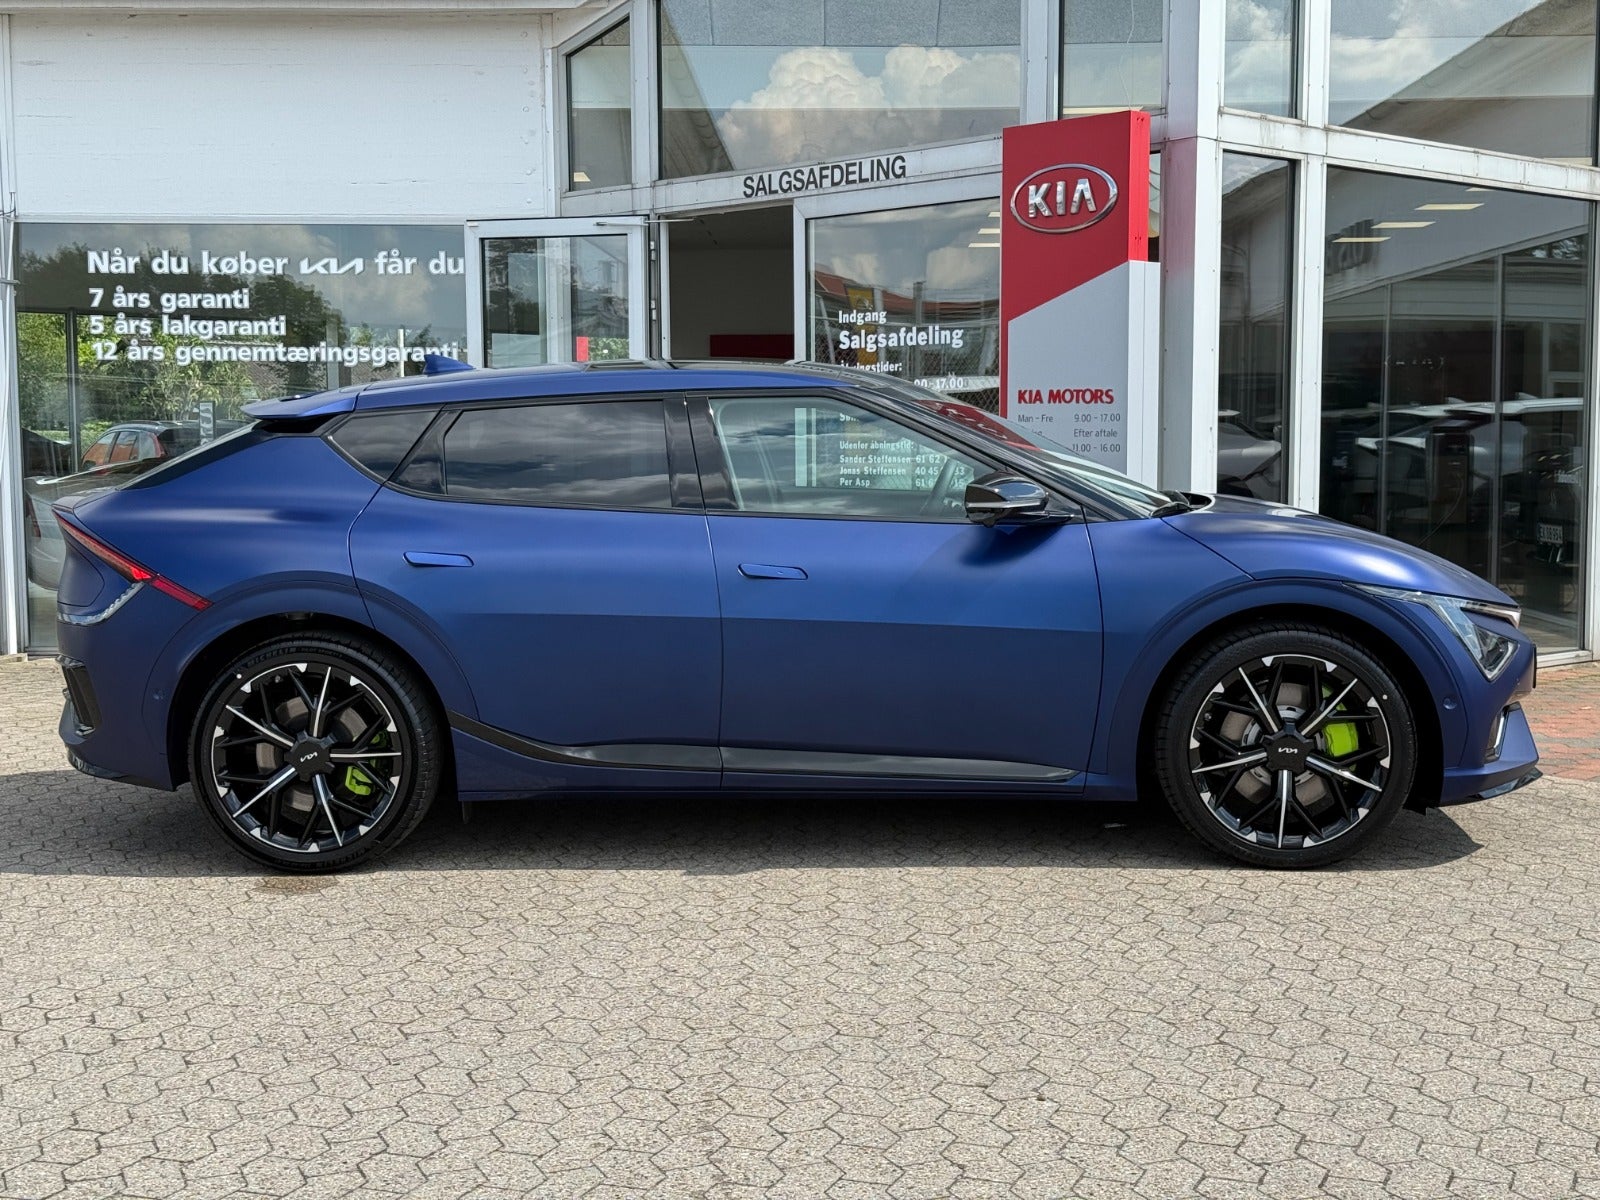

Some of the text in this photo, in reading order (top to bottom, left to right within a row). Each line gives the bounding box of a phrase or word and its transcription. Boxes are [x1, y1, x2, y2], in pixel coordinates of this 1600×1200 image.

[742, 154, 907, 199] SALGSAFDELING
[1028, 178, 1097, 218] KIA
[87, 247, 140, 274] Når
[151, 250, 189, 275] du
[201, 250, 288, 275] køber
[374, 248, 417, 275] får
[429, 250, 465, 275] du
[88, 285, 250, 313] 7 års garanti
[838, 310, 887, 325] Indgang
[89, 312, 287, 340] 5 års lakgaranti
[839, 325, 964, 352] Salgsafdeling
[92, 340, 118, 361] 12
[127, 338, 165, 361] års
[1017, 388, 1115, 405] KIA MOTORS
[1017, 414, 1034, 423] Man
[1041, 414, 1053, 423] Fre
[1074, 413, 1092, 423] 9.00
[1100, 413, 1121, 422] 17.00
[1073, 428, 1118, 438] Efter aftale
[839, 440, 914, 451] Udenfor åbningstid:
[1100, 443, 1121, 453] 16.00
[839, 454, 867, 463] Sander
[867, 454, 911, 463] Steffensen
[839, 466, 860, 475] Jonas
[864, 466, 906, 475] Steffensen
[915, 466, 926, 475] 40
[839, 477, 855, 486] Per
[855, 477, 871, 487] Asp
